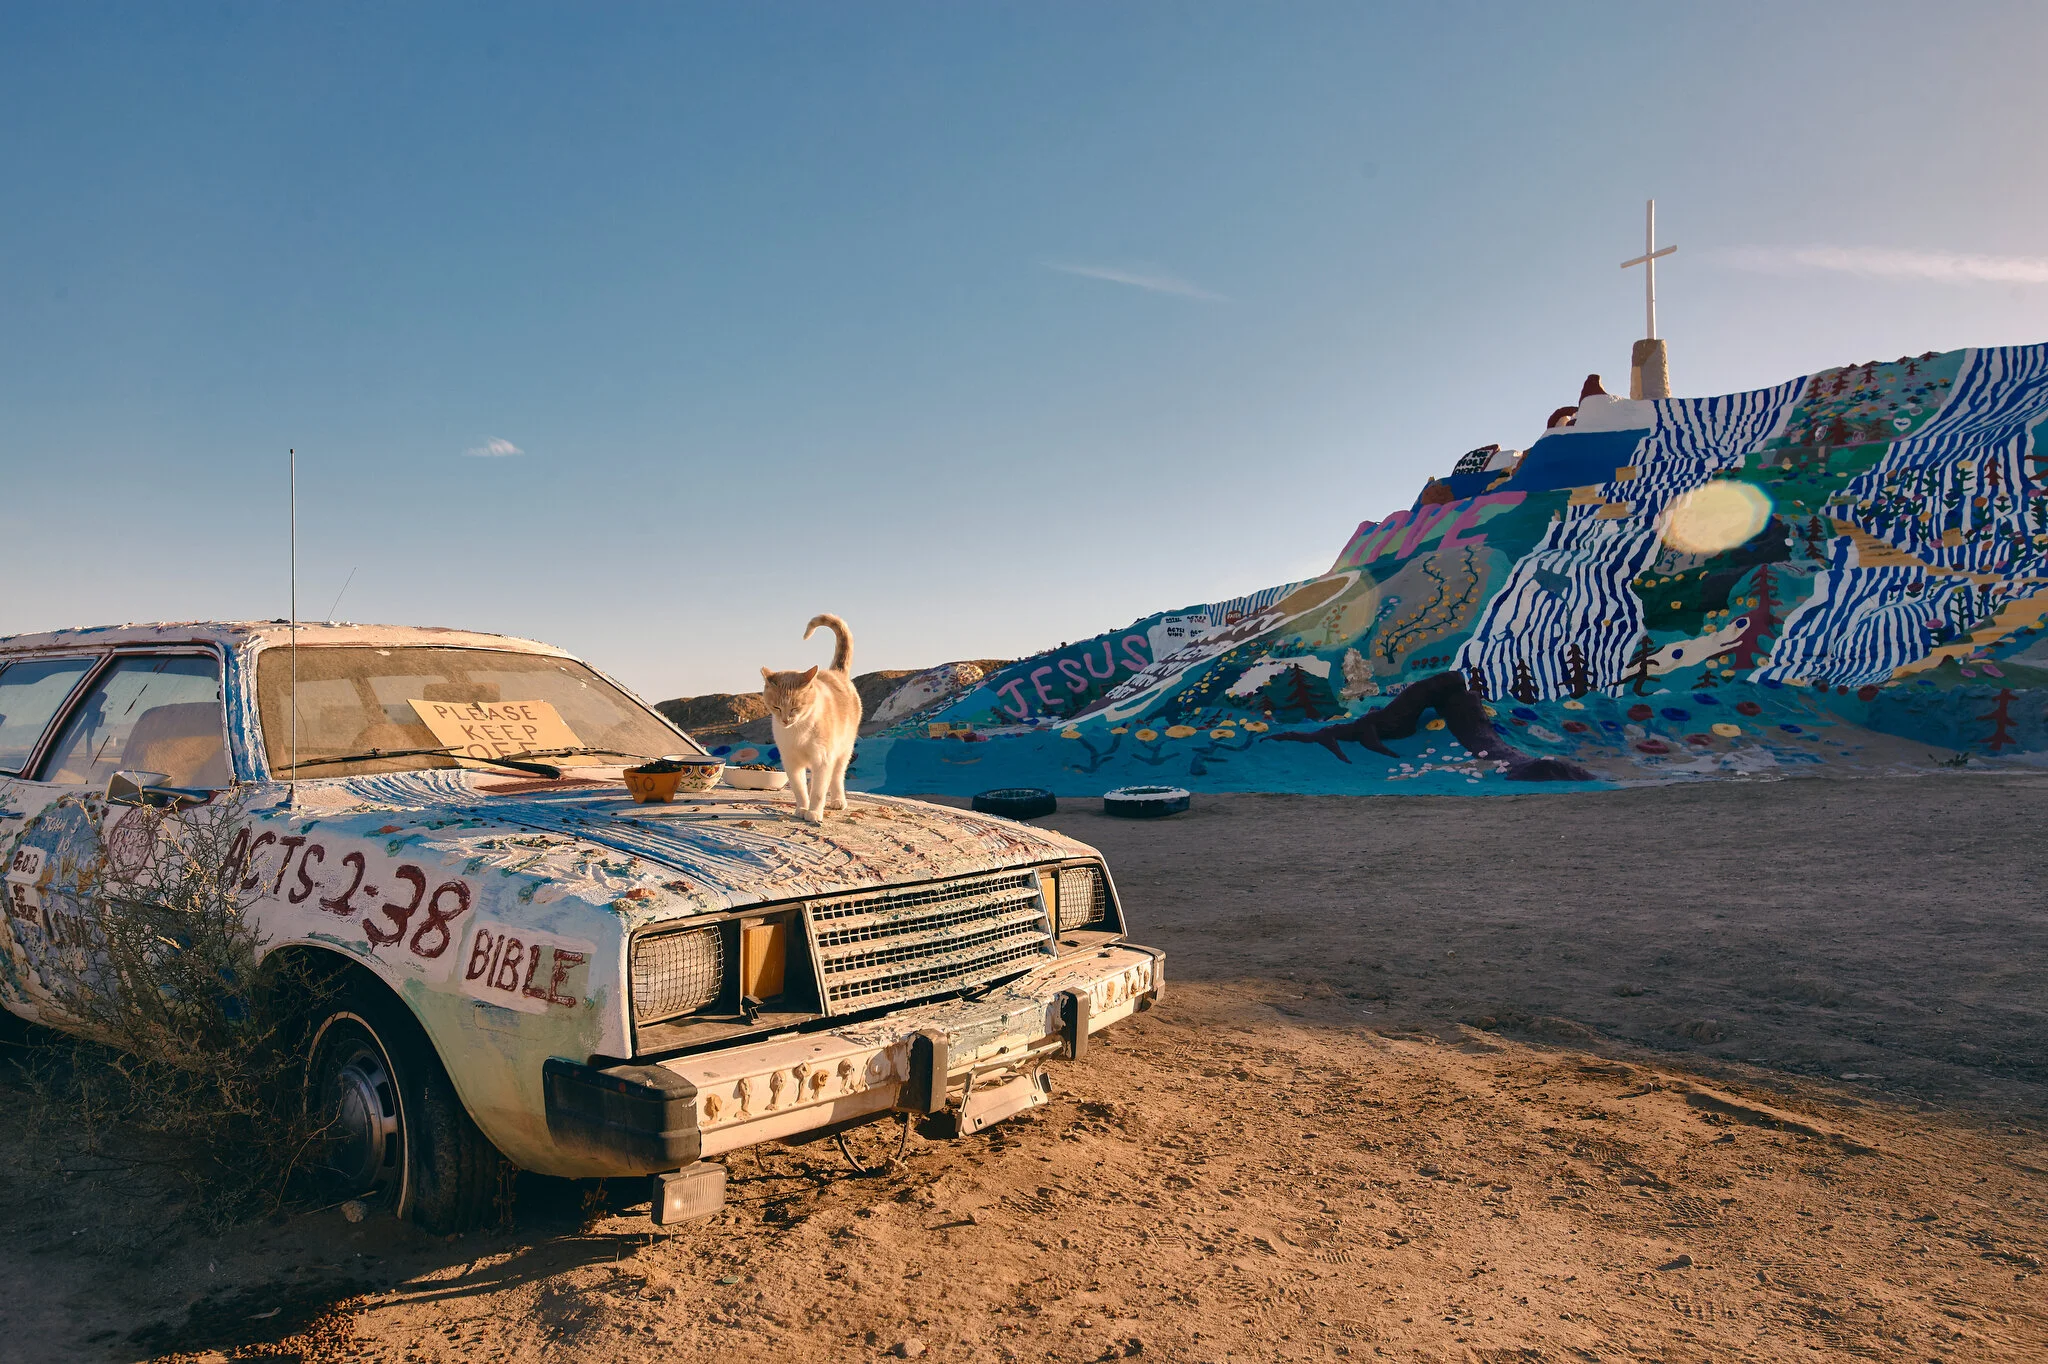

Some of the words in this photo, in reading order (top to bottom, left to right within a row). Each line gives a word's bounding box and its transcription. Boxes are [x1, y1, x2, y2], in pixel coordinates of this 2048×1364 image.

[996, 635, 1149, 719] JESUS
[433, 704, 538, 721] PLEASE
[460, 724, 538, 741] KEEP
[12, 850, 39, 875] GOD
[465, 928, 586, 1009] BIBLE
